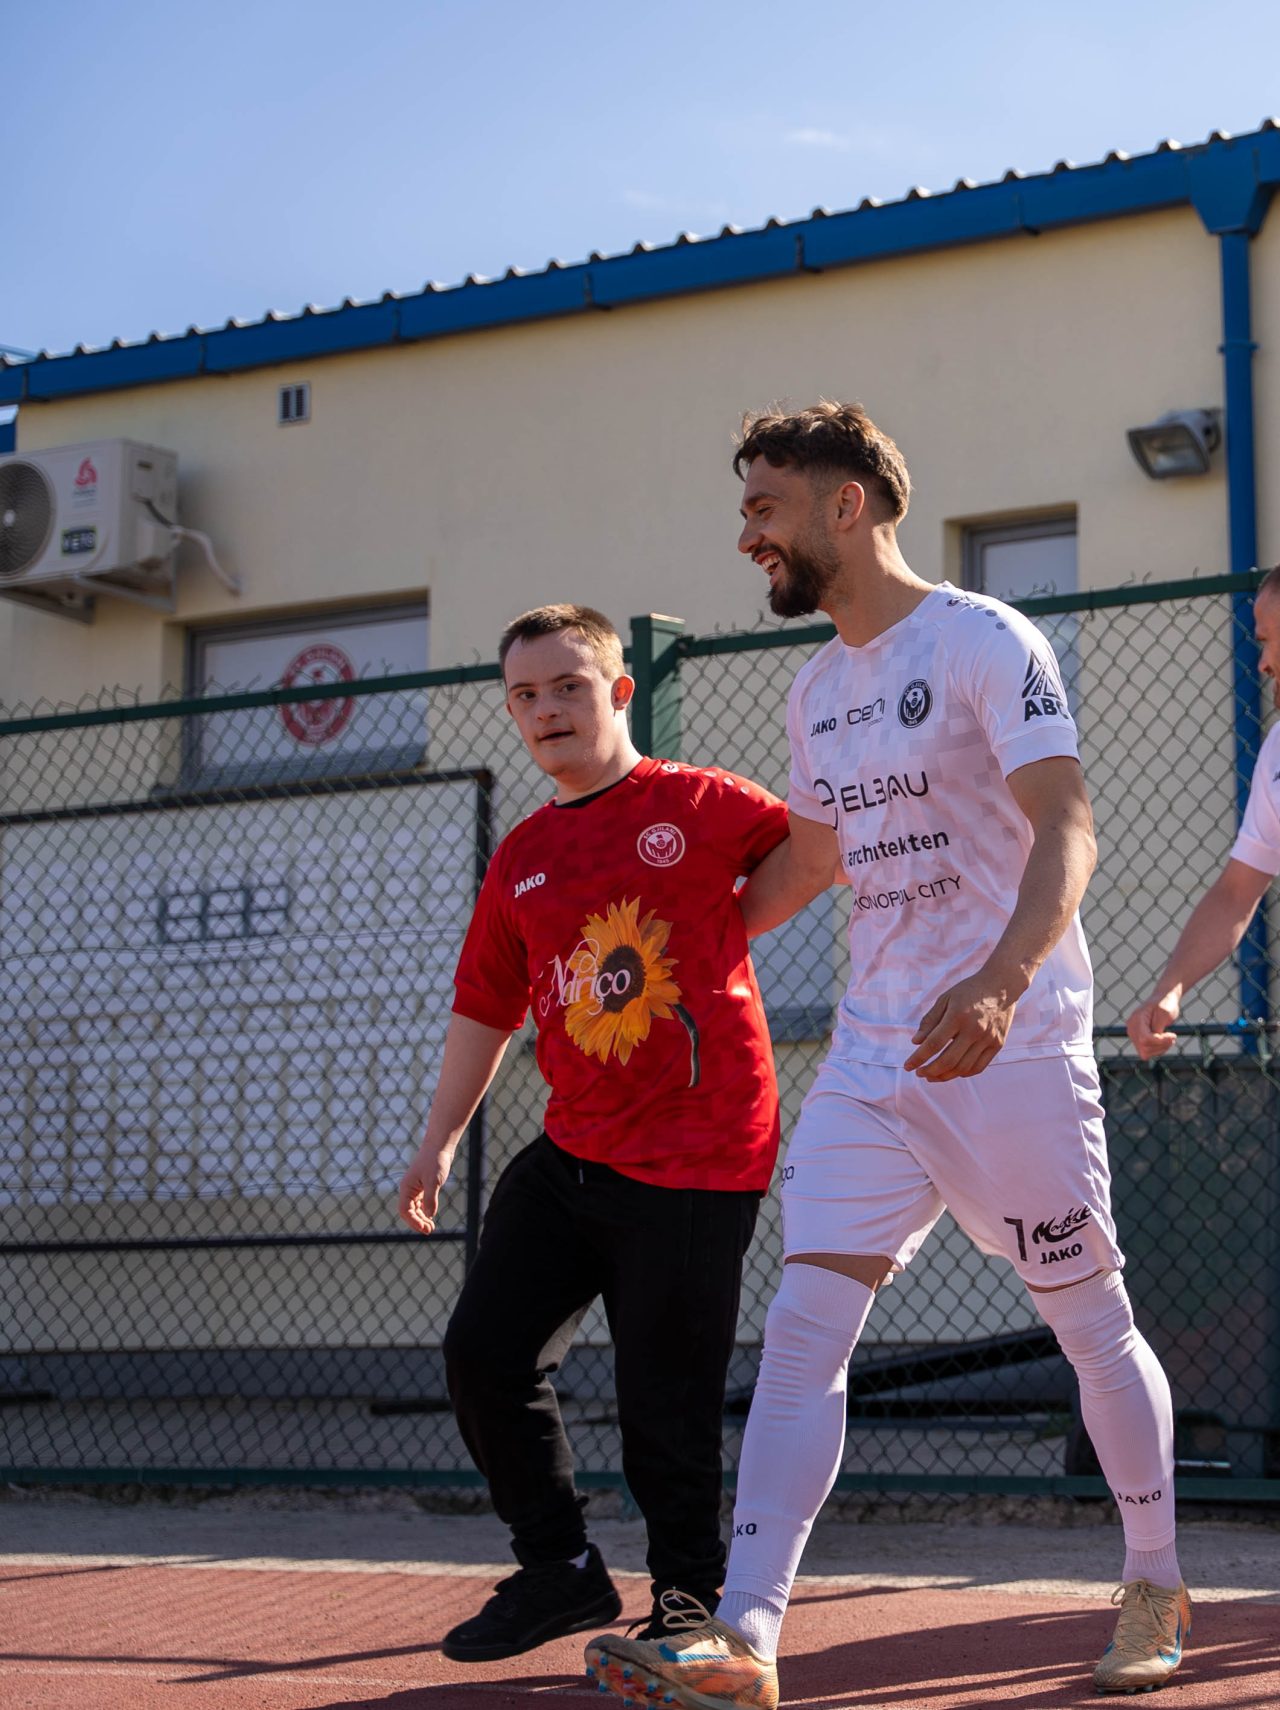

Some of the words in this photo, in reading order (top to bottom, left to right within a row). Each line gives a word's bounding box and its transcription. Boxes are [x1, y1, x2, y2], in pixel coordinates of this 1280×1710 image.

[810, 717, 837, 738] JAKO
[514, 872, 546, 899] JAKO
[918, 875, 961, 899] CITY
[1040, 1243, 1084, 1265] JAKO
